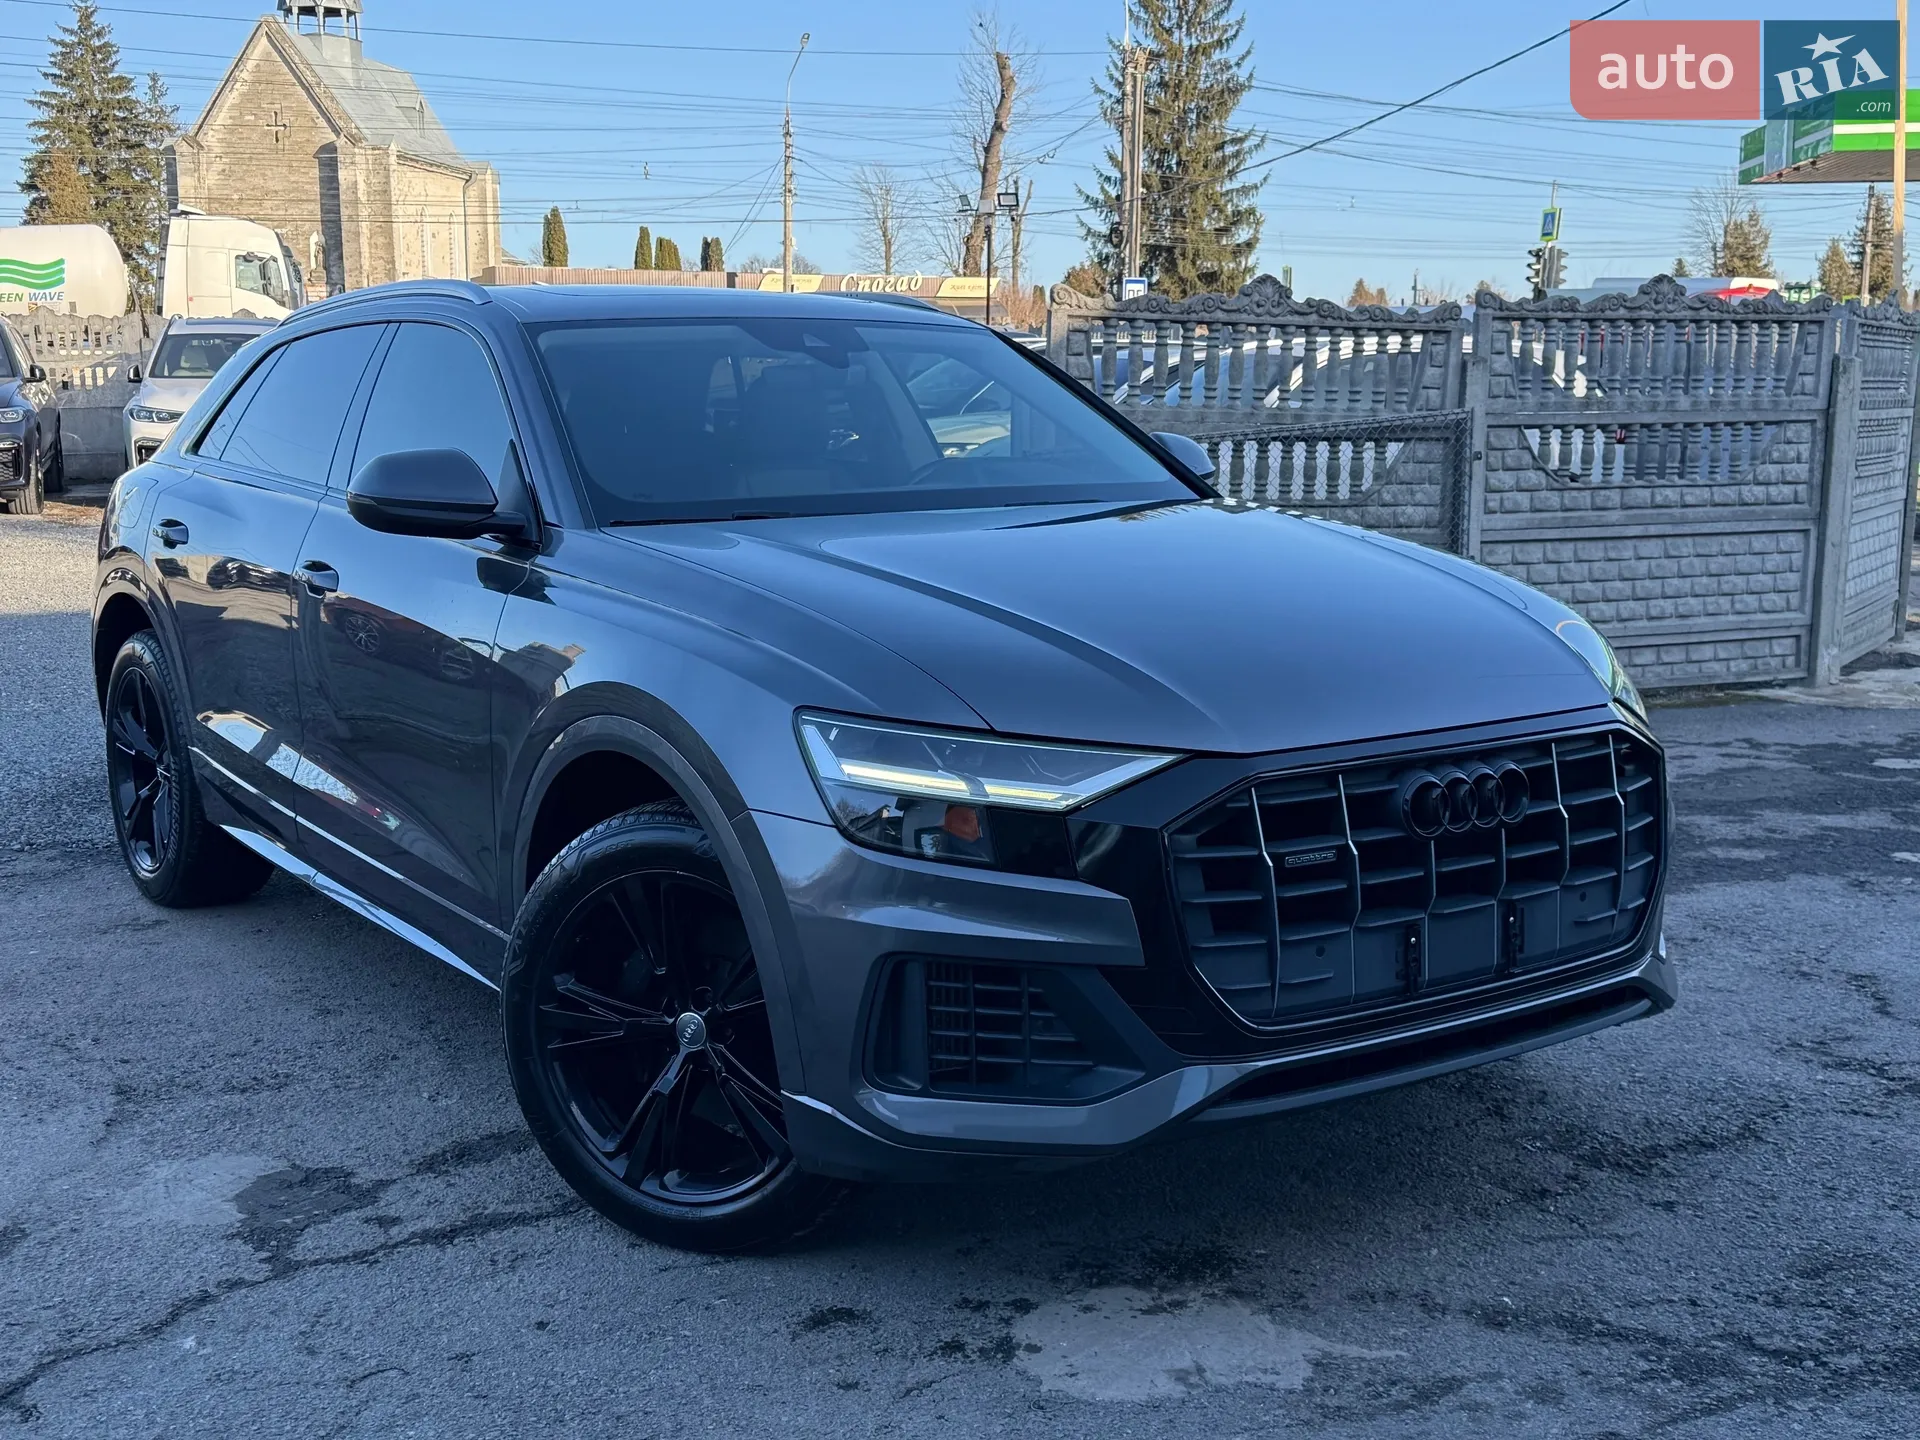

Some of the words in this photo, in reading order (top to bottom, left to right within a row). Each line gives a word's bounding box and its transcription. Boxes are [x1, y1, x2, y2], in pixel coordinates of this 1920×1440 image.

[839, 270, 923, 292] Спогад
[28, 291, 65, 302] WAVE
[1288, 853, 1334, 864] quattro
